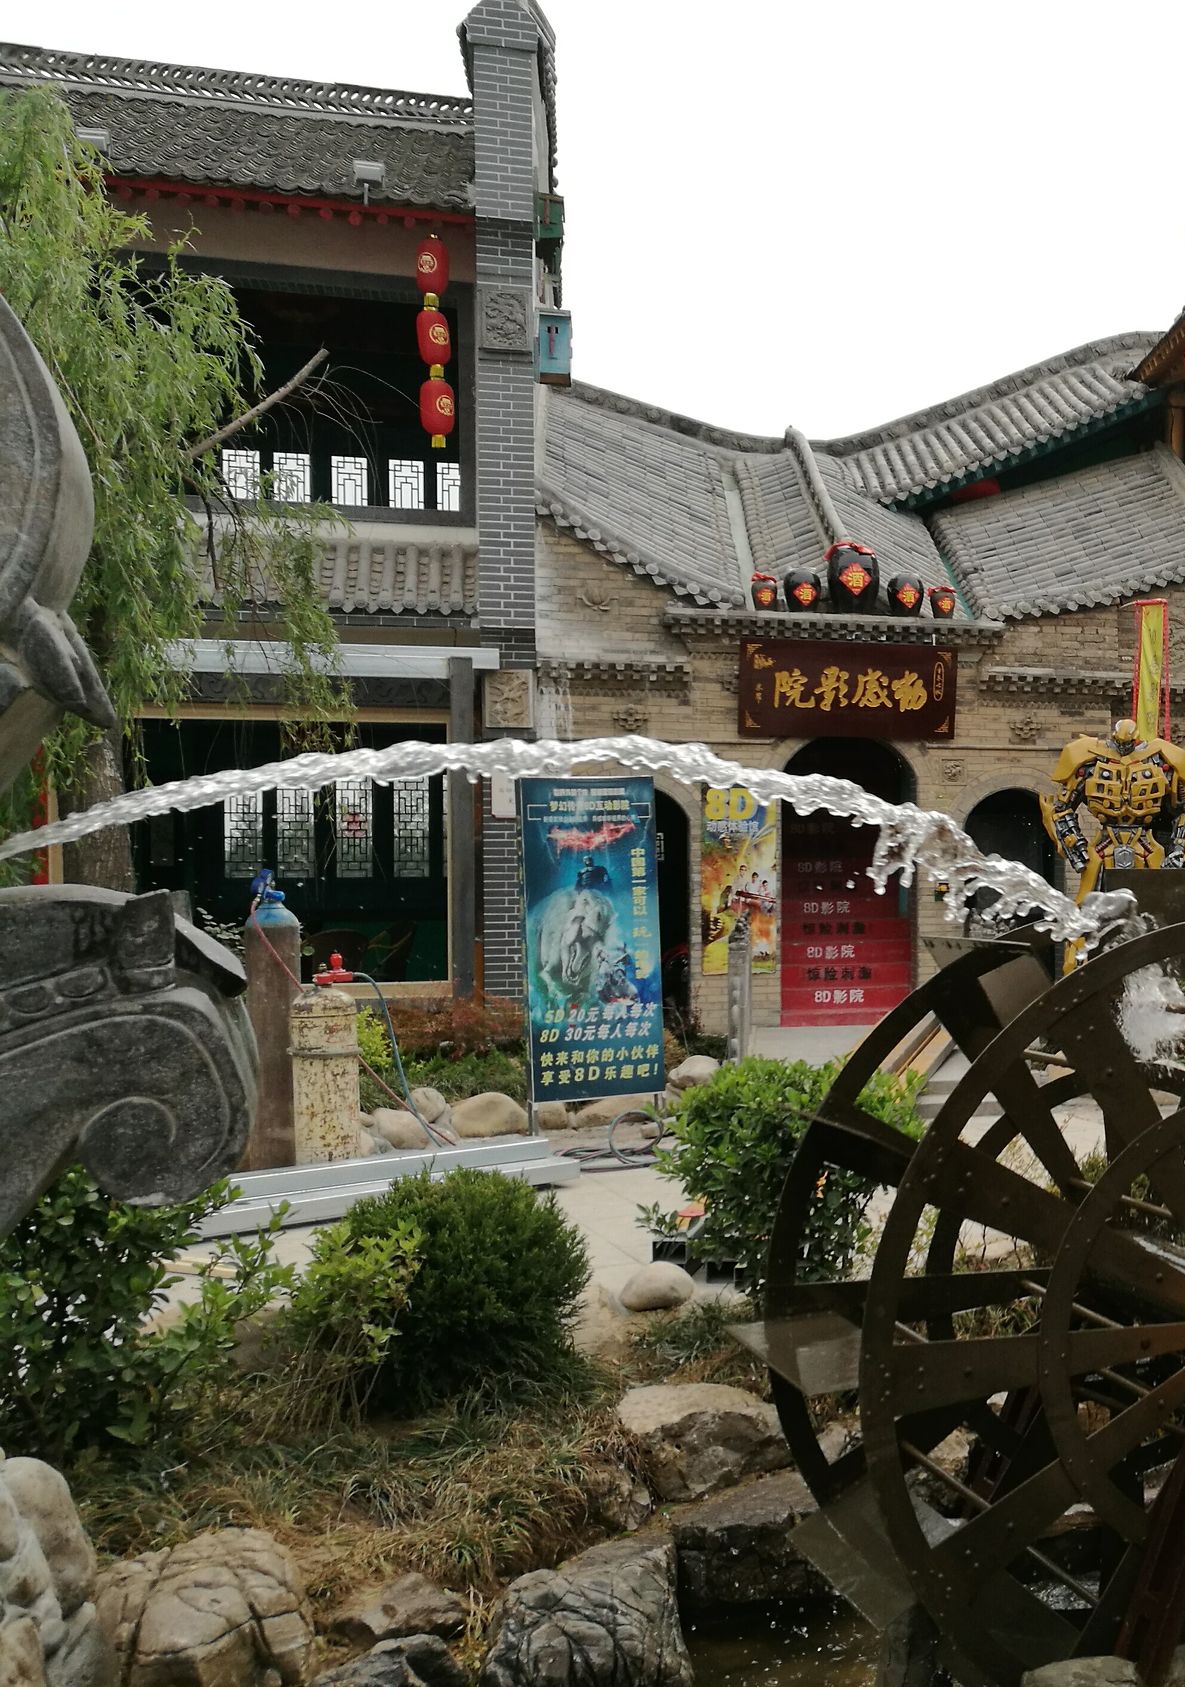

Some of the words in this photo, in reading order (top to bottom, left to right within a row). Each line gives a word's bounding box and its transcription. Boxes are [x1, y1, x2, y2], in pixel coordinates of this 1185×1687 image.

[847, 572, 863, 587] 酒
[705, 787, 758, 820] 8D
[803, 901, 851, 914] 8D影院
[807, 944, 855, 959] 8D影院
[814, 989, 865, 1004] 8D影院
[539, 1029, 560, 1043] 8D
[564, 1021, 652, 1042] 30元每人每次
[540, 1044, 659, 1068] 快来和你的小伙伴
